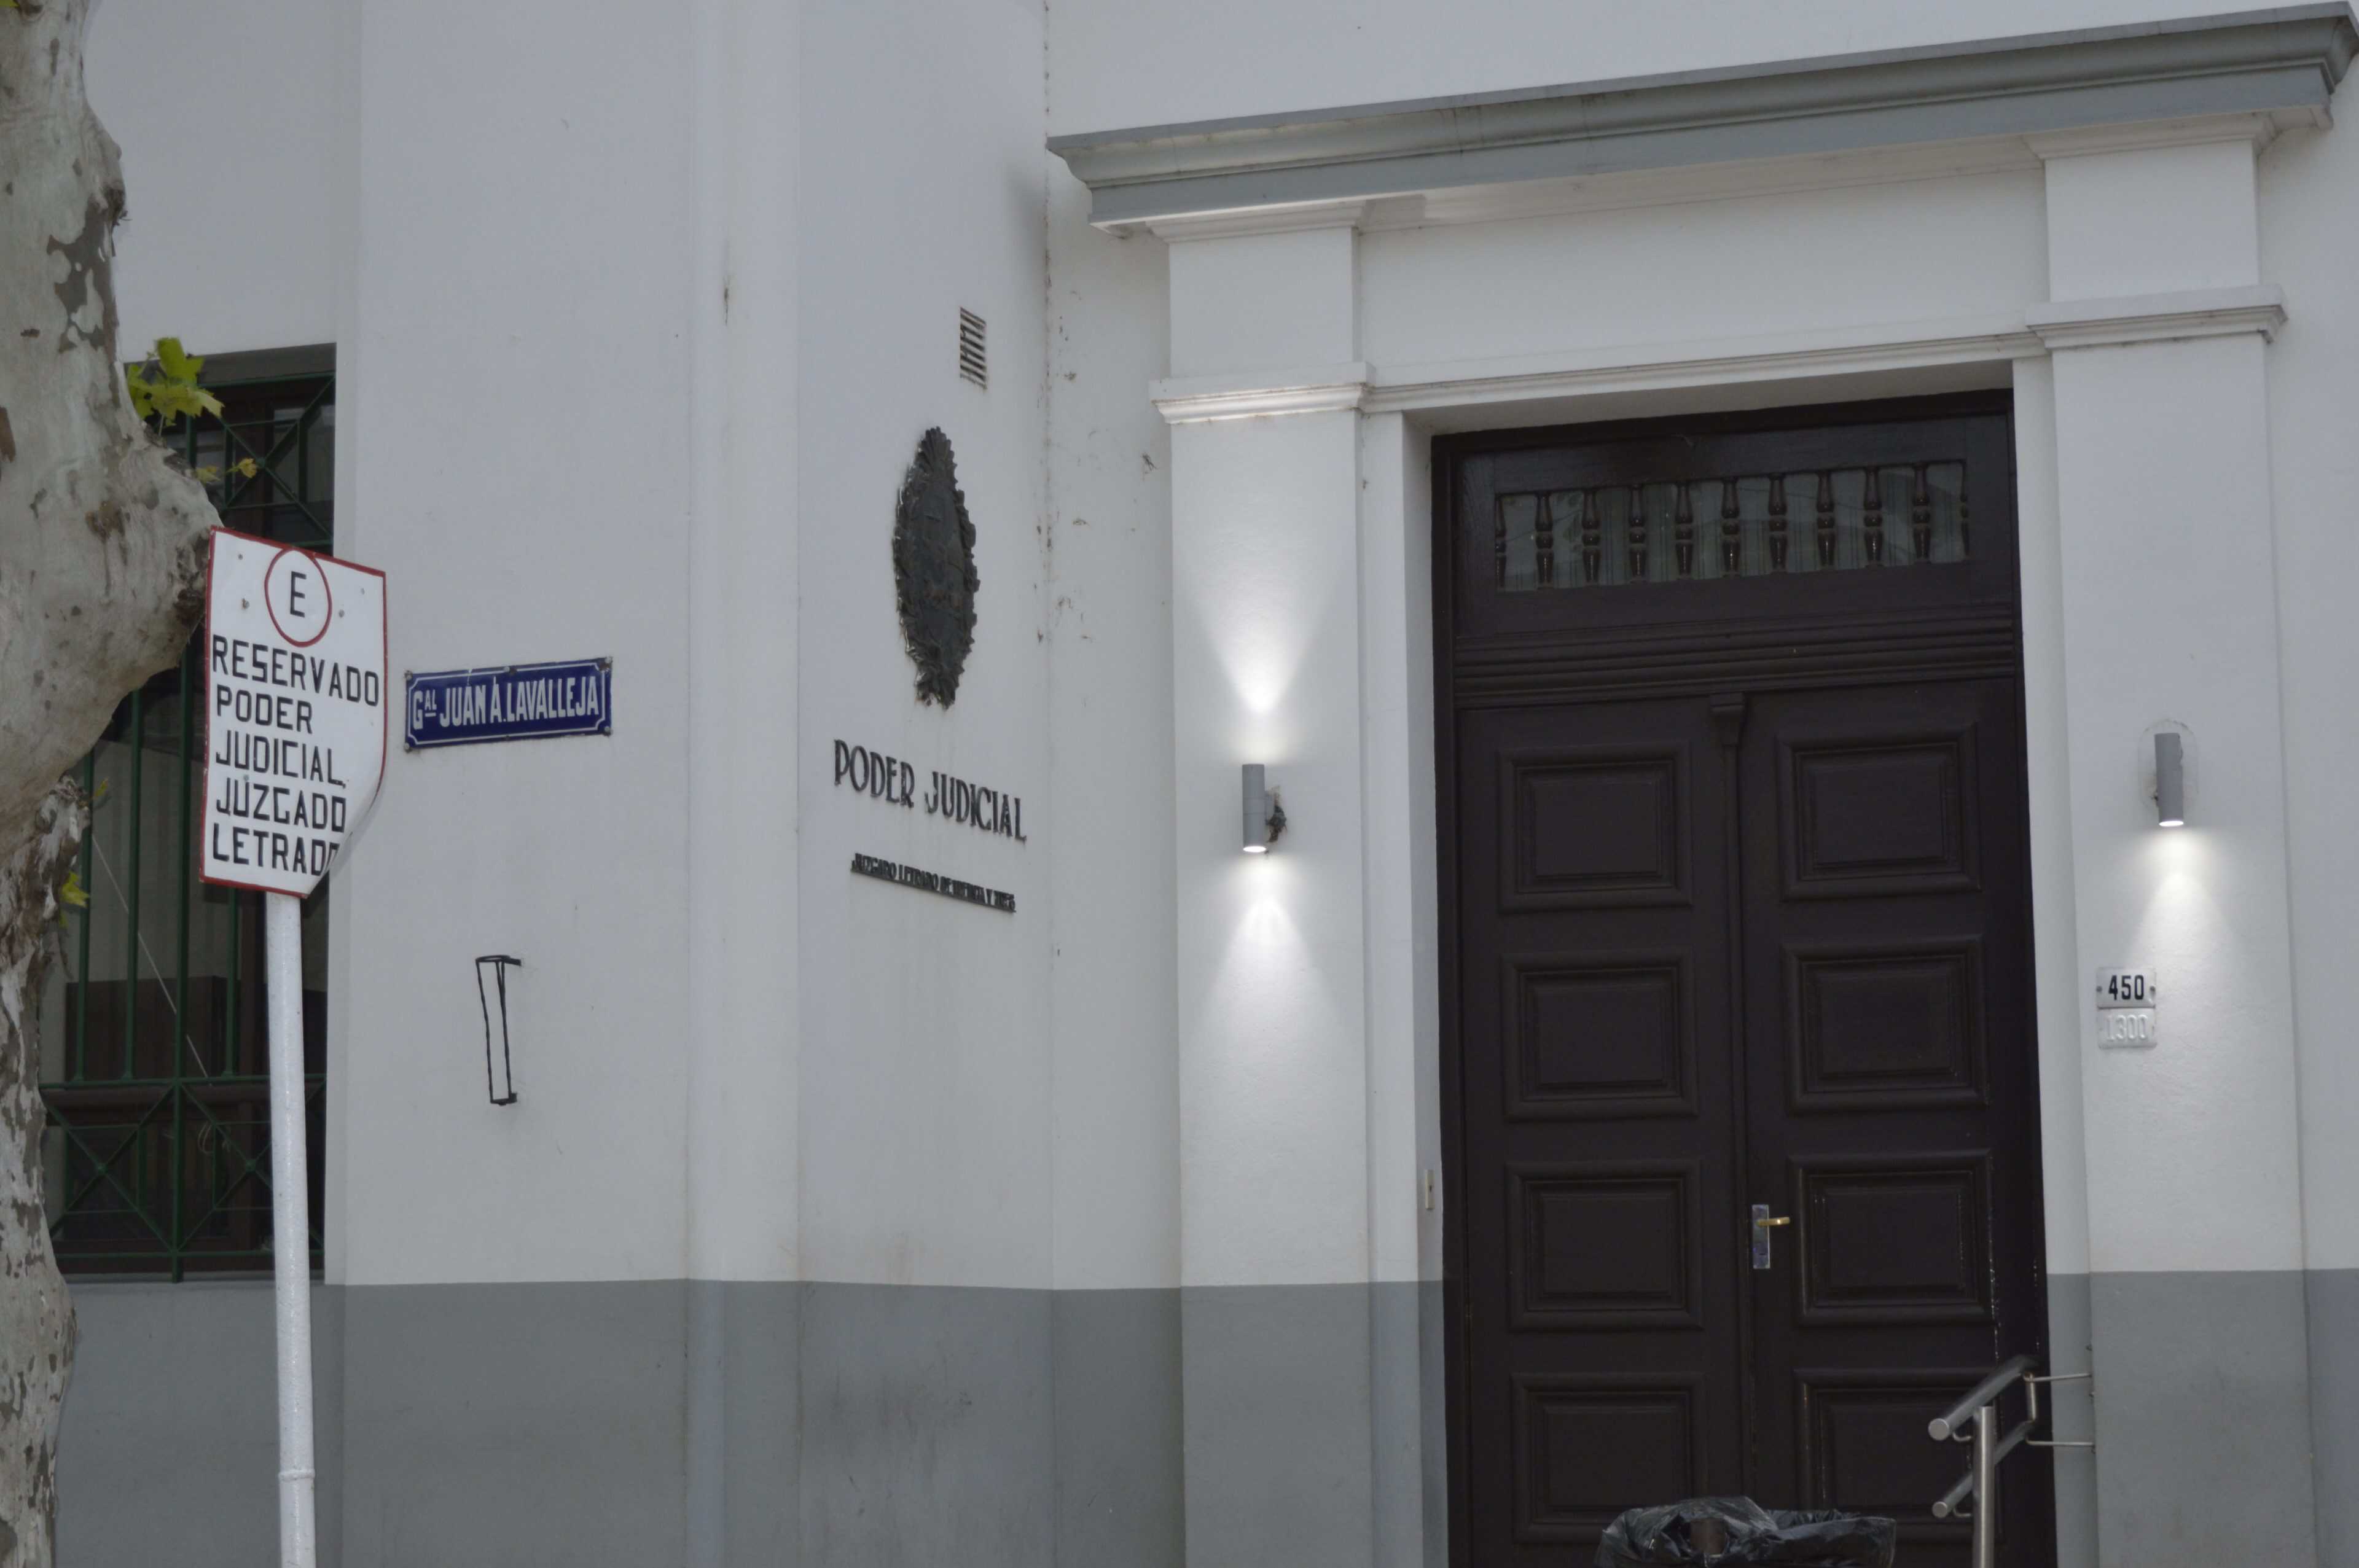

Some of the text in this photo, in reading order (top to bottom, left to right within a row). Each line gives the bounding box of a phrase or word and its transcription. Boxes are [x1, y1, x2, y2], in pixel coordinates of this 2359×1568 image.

[289, 571, 307, 617] E
[212, 634, 379, 706] RESERVADO
[216, 685, 312, 734] PODER
[440, 684, 486, 727] JUAN
[216, 778, 346, 833] JUZGADO
[834, 739, 1027, 842] PODER JUDICIAL
[2108, 975, 2144, 1000] 450
